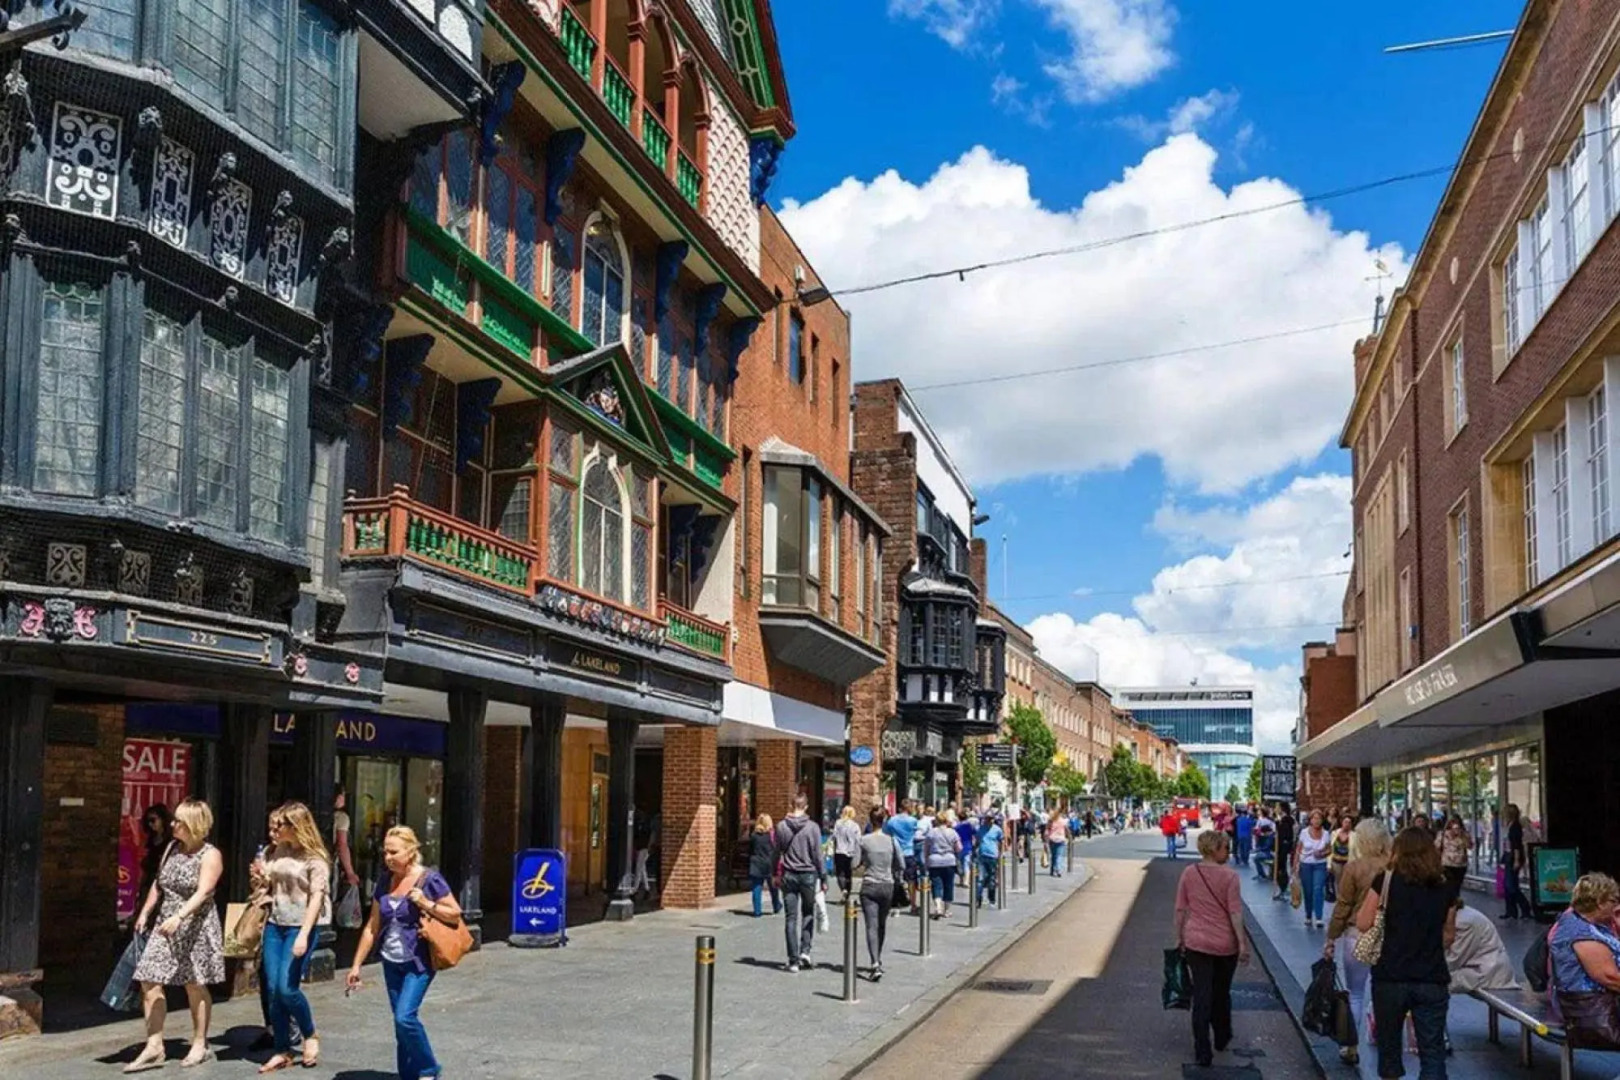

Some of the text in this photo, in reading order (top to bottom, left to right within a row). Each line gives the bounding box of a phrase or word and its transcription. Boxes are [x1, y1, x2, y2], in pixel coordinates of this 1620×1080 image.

[191, 631, 218, 645] 225
[122, 744, 186, 775] SALE
[519, 905, 557, 915] LAKELAND
